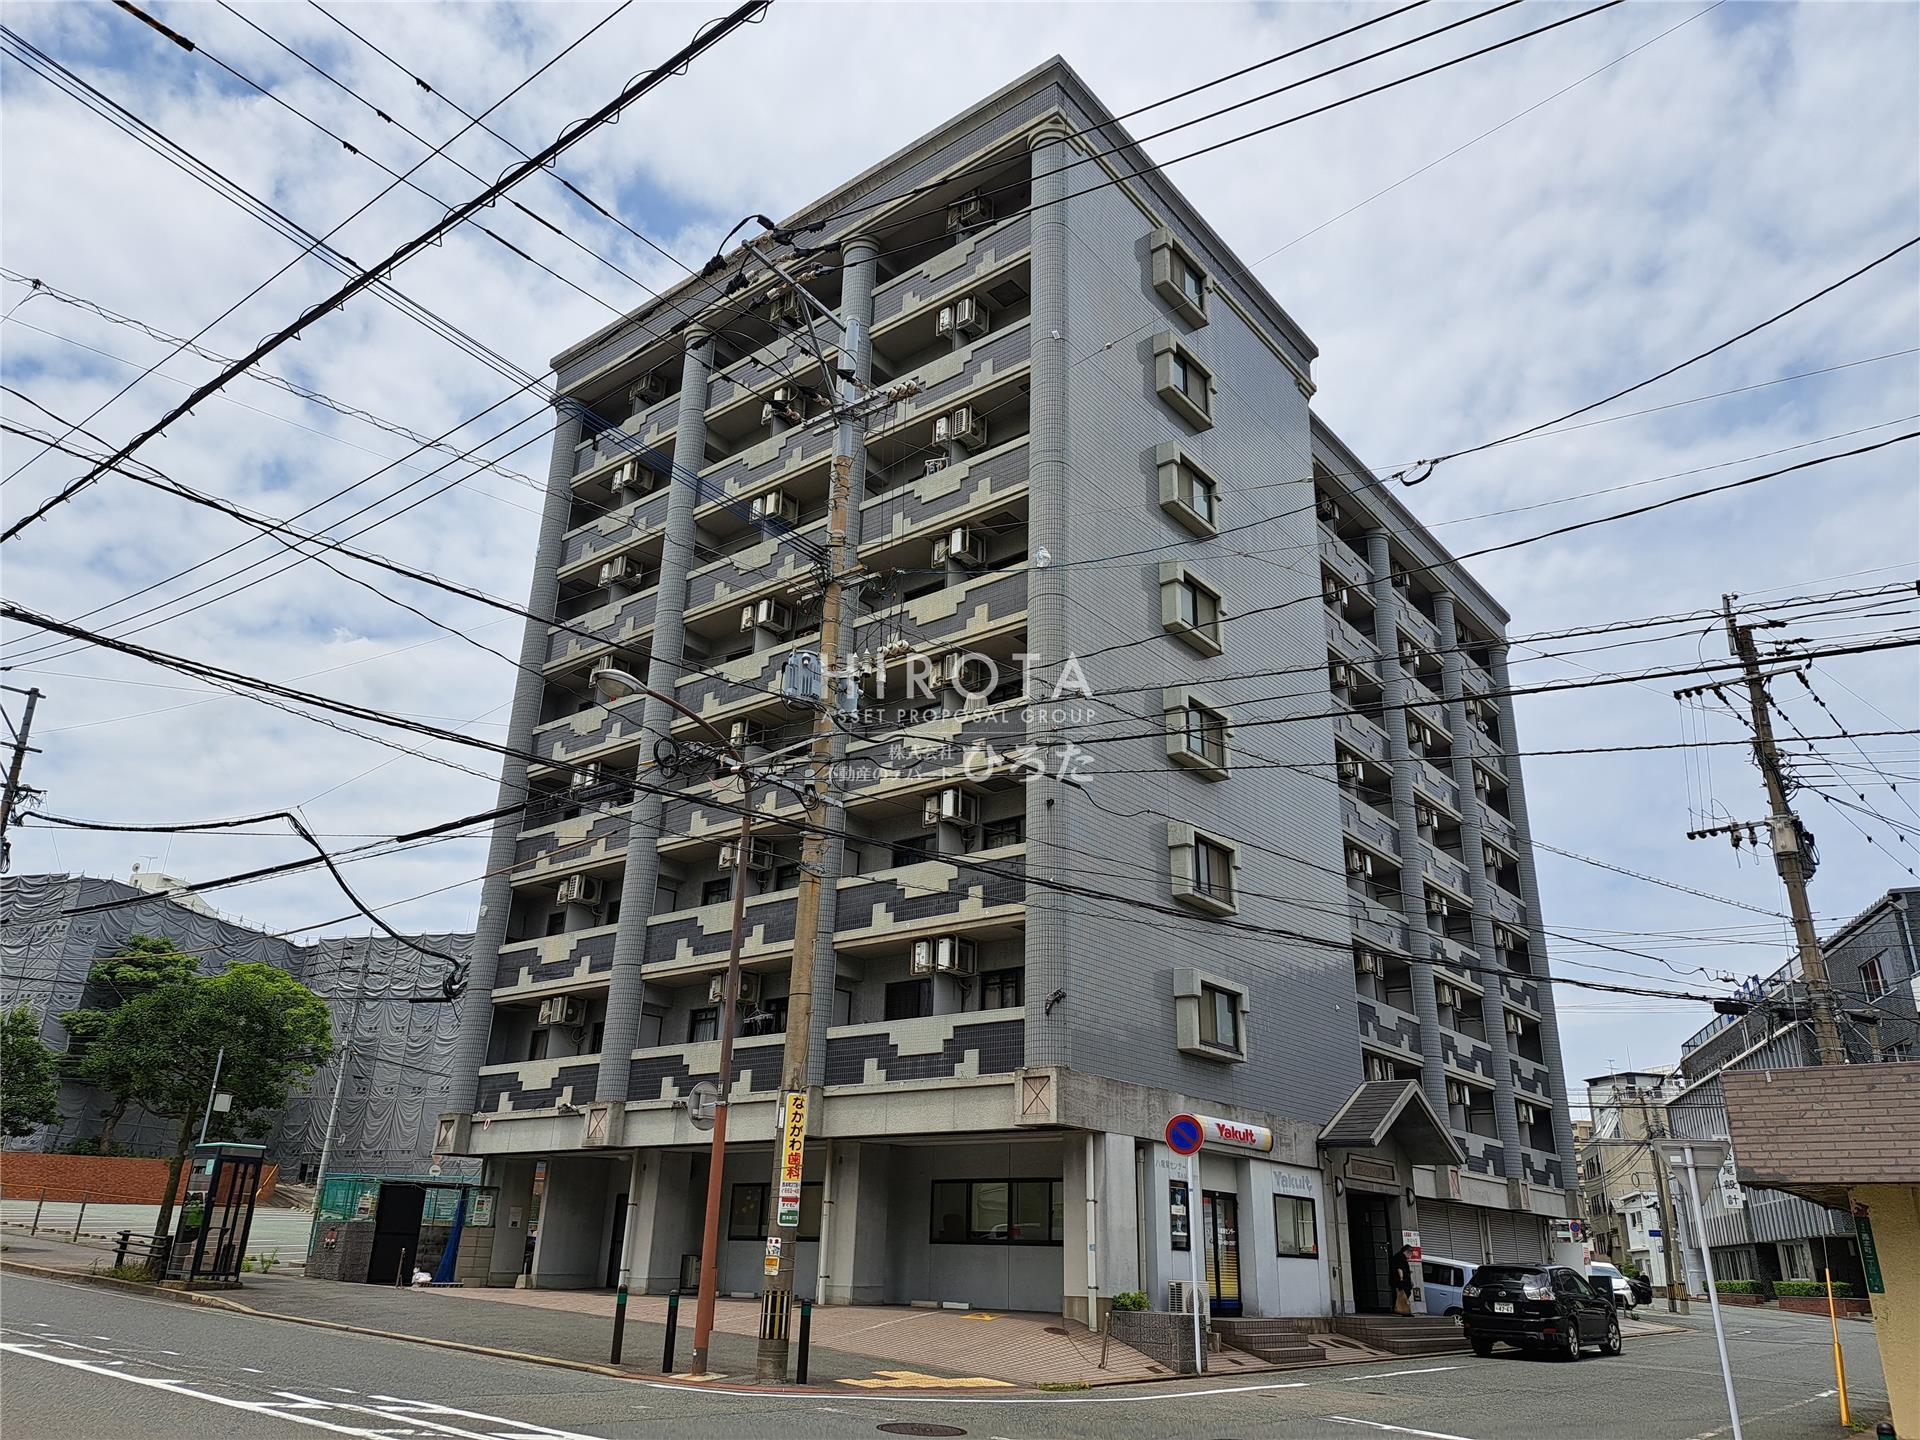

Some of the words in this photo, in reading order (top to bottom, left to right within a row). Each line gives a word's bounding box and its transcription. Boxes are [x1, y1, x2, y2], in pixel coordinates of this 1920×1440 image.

[786, 1096, 805, 1180] なかがわ歯科
[1215, 1123, 1257, 1144] Yakult
[1273, 1170, 1312, 1192] Yakult
